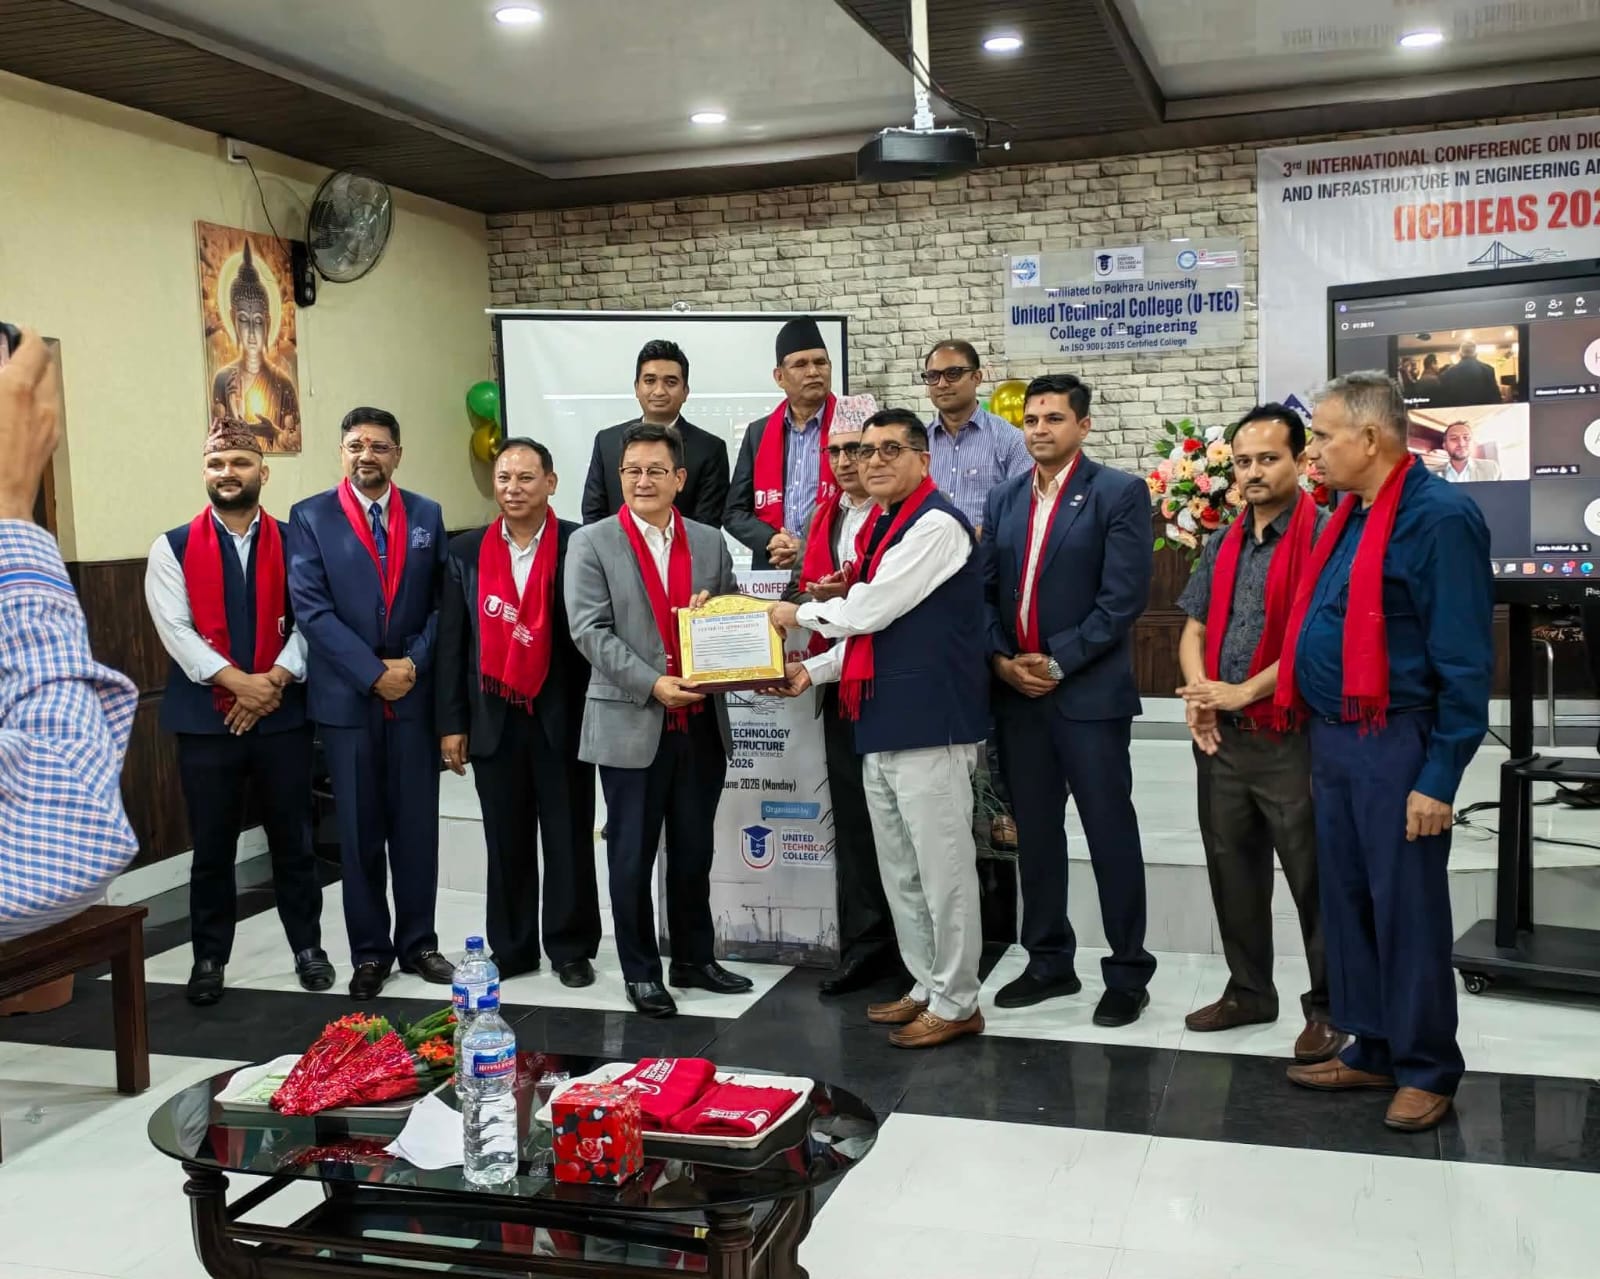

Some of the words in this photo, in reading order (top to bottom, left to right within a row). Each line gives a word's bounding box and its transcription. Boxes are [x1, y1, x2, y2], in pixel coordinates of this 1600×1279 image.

[1283, 160, 1302, 178] 3rd
[1307, 148, 1430, 176] INTERNATIONAL
[1435, 137, 1542, 164] CONFERENCE
[1548, 134, 1571, 152] ON
[1282, 185, 1313, 202] AND
[1318, 172, 1449, 199] INFRASTRUCTURE
[1455, 170, 1470, 187] IN
[1476, 160, 1580, 185] ENGINEERING
[1394, 194, 1538, 242] (ICDIEAS
[1092, 285, 1102, 296] to
[1147, 277, 1197, 292] University
[1011, 303, 1055, 325] United
[1058, 299, 1125, 322] Technical
[1129, 296, 1182, 318] College
[1187, 289, 1239, 315] (U-TEC)
[1050, 325, 1096, 342] College
[1100, 322, 1114, 337] of
[1117, 319, 1198, 339] Engineering
[1060, 344, 1069, 352] An
[1071, 342, 1085, 352] ISO
[1127, 338, 1158, 348] Certified
[1160, 337, 1187, 347] College
[729, 758, 754, 769] 2026
[723, 780, 739, 789] une
[740, 778, 760, 790] 2026
[762, 778, 797, 792] (Monday)
[782, 834, 814, 843] UNITED
[782, 842, 827, 852] TECHNICA
[782, 851, 820, 861] COLLEGE
